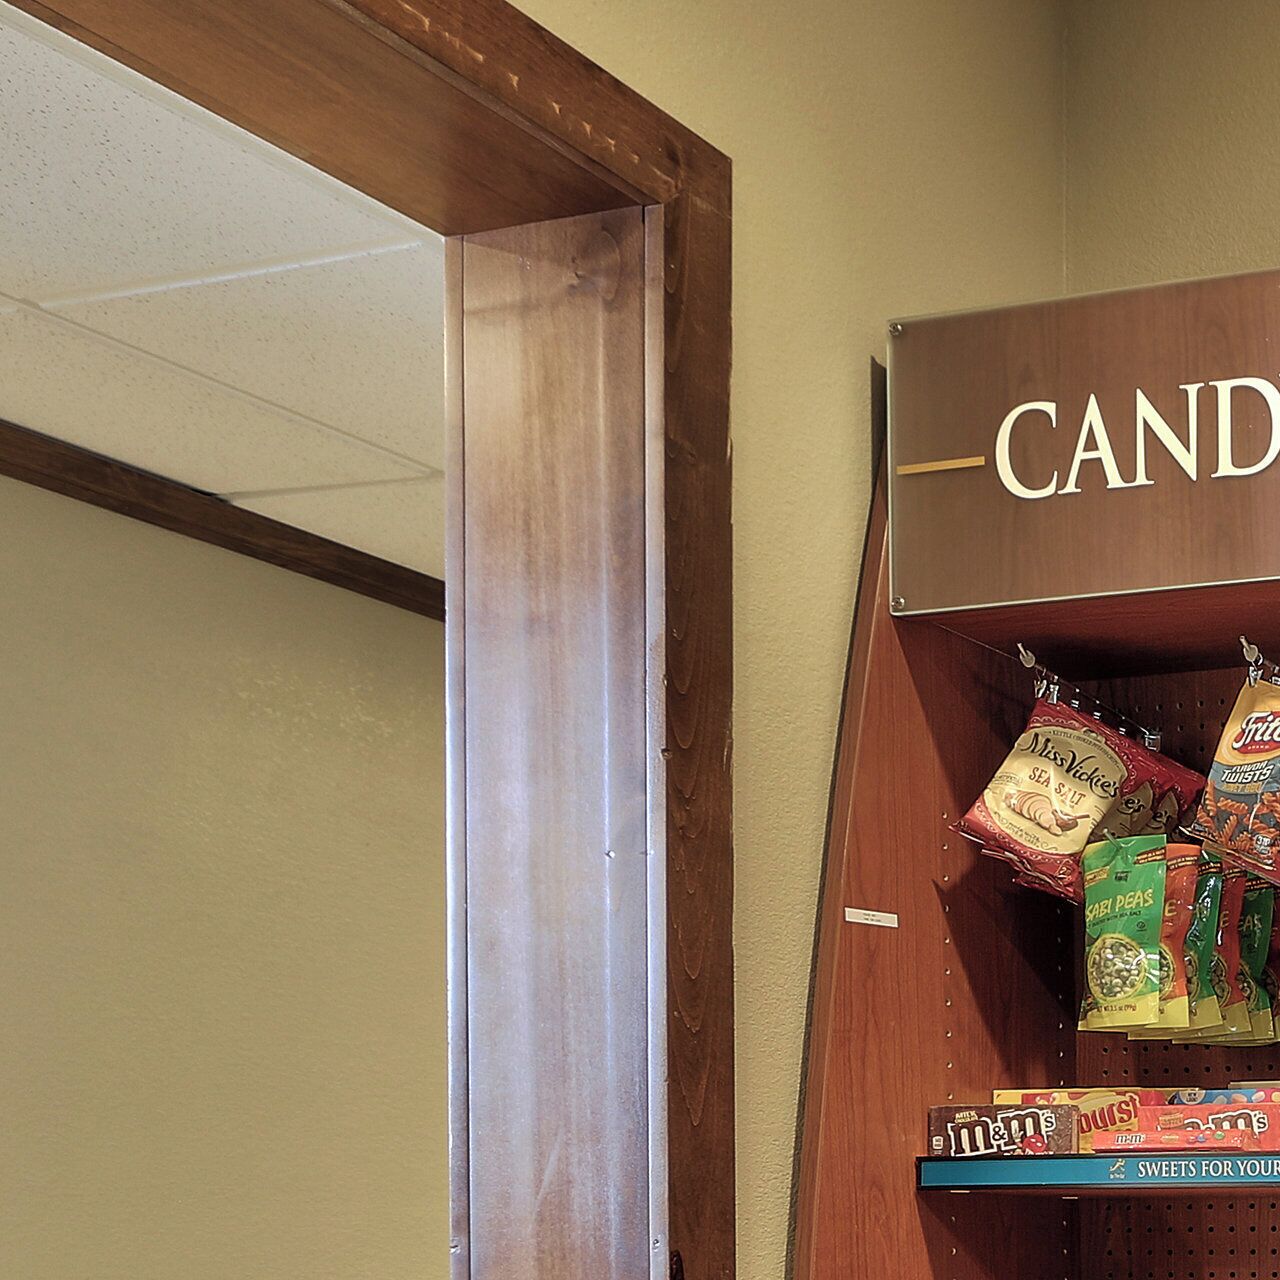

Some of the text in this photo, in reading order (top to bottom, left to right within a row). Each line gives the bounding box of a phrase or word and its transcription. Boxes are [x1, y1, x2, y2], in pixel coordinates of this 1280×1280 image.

[1021, 732, 1067, 768] Miss
[1064, 751, 1120, 798] Vickie's
[1221, 765, 1274, 782] TWISTS
[1029, 766, 1087, 807] SEA SALT
[1086, 889, 1154, 922] SABI PEAS
[1137, 1160, 1196, 1178] SWEETS
[1202, 1160, 1233, 1176] FOR
